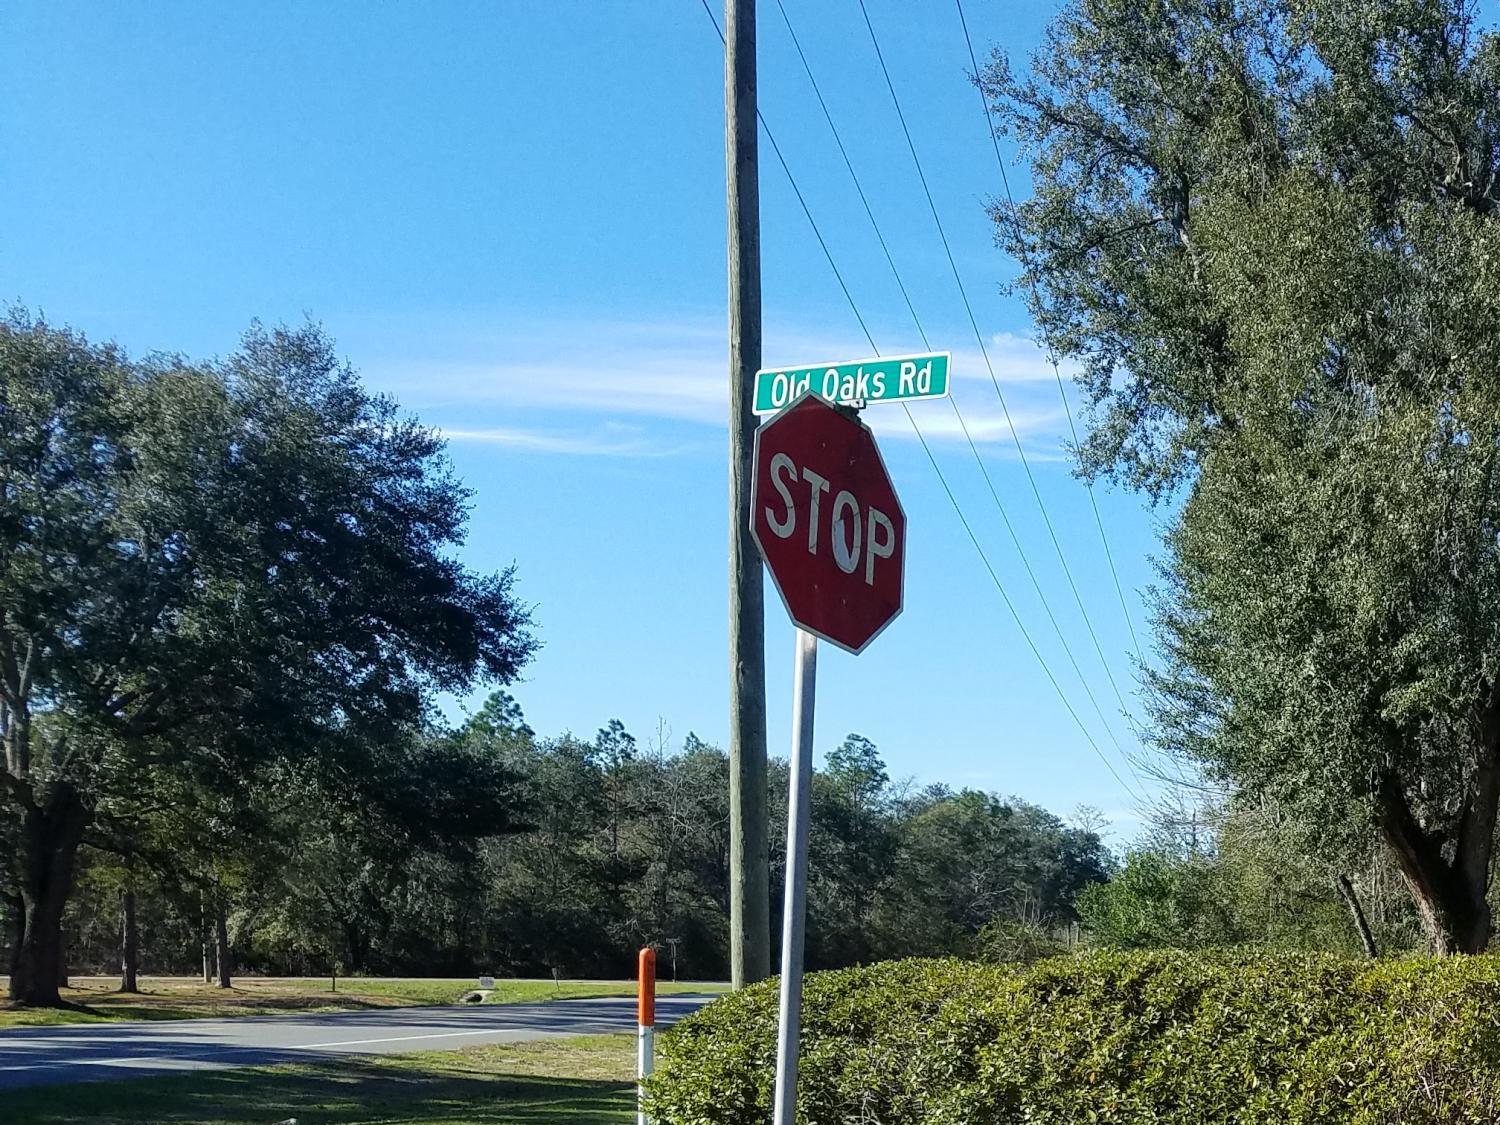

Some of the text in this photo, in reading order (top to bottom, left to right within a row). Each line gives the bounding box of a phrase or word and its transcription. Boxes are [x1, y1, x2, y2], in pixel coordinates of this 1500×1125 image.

[822, 366, 886, 401] Oaks
[898, 360, 932, 395] Rd
[765, 452, 895, 586] STOP
